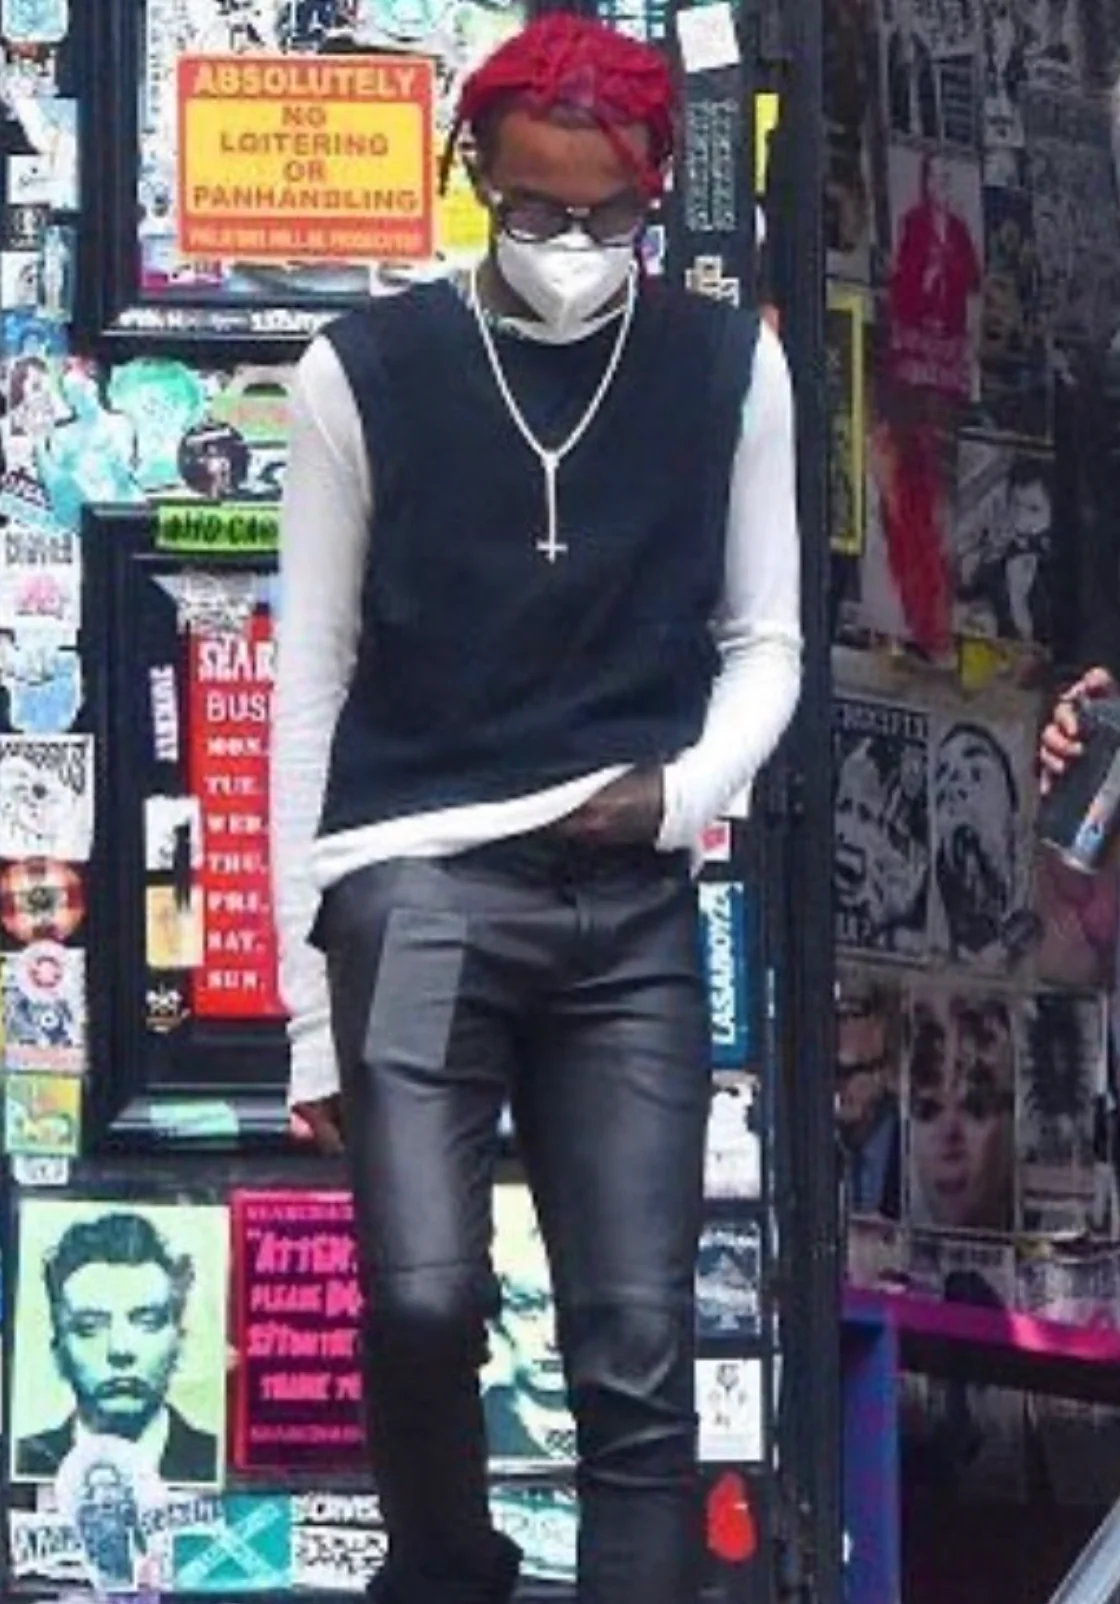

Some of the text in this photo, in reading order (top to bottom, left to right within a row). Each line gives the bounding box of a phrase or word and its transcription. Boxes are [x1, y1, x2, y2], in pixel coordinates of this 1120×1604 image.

[194, 64, 417, 96] ABSOLUTELY
[281, 106, 327, 127] NO
[220, 131, 389, 157] LOITERING
[282, 160, 325, 182] OR
[193, 185, 419, 211] PANHANDLING
